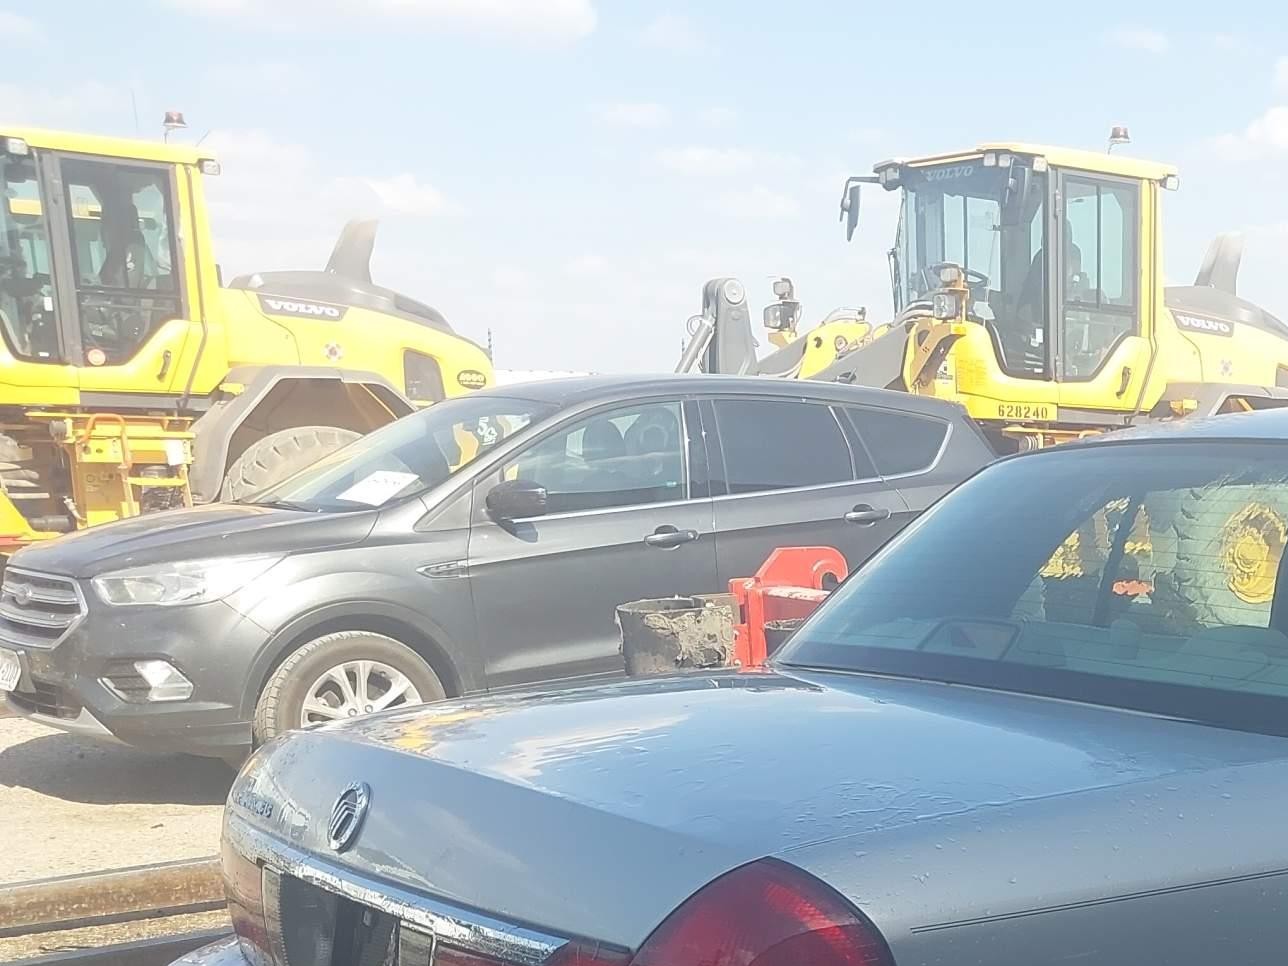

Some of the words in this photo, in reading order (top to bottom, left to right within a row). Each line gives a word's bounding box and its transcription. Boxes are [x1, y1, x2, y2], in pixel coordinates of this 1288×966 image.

[924, 165, 975, 181] VOLVO
[265, 300, 340, 317] VOLVO
[1177, 316, 1230, 332] VOLVO
[998, 404, 1048, 419] 628240
